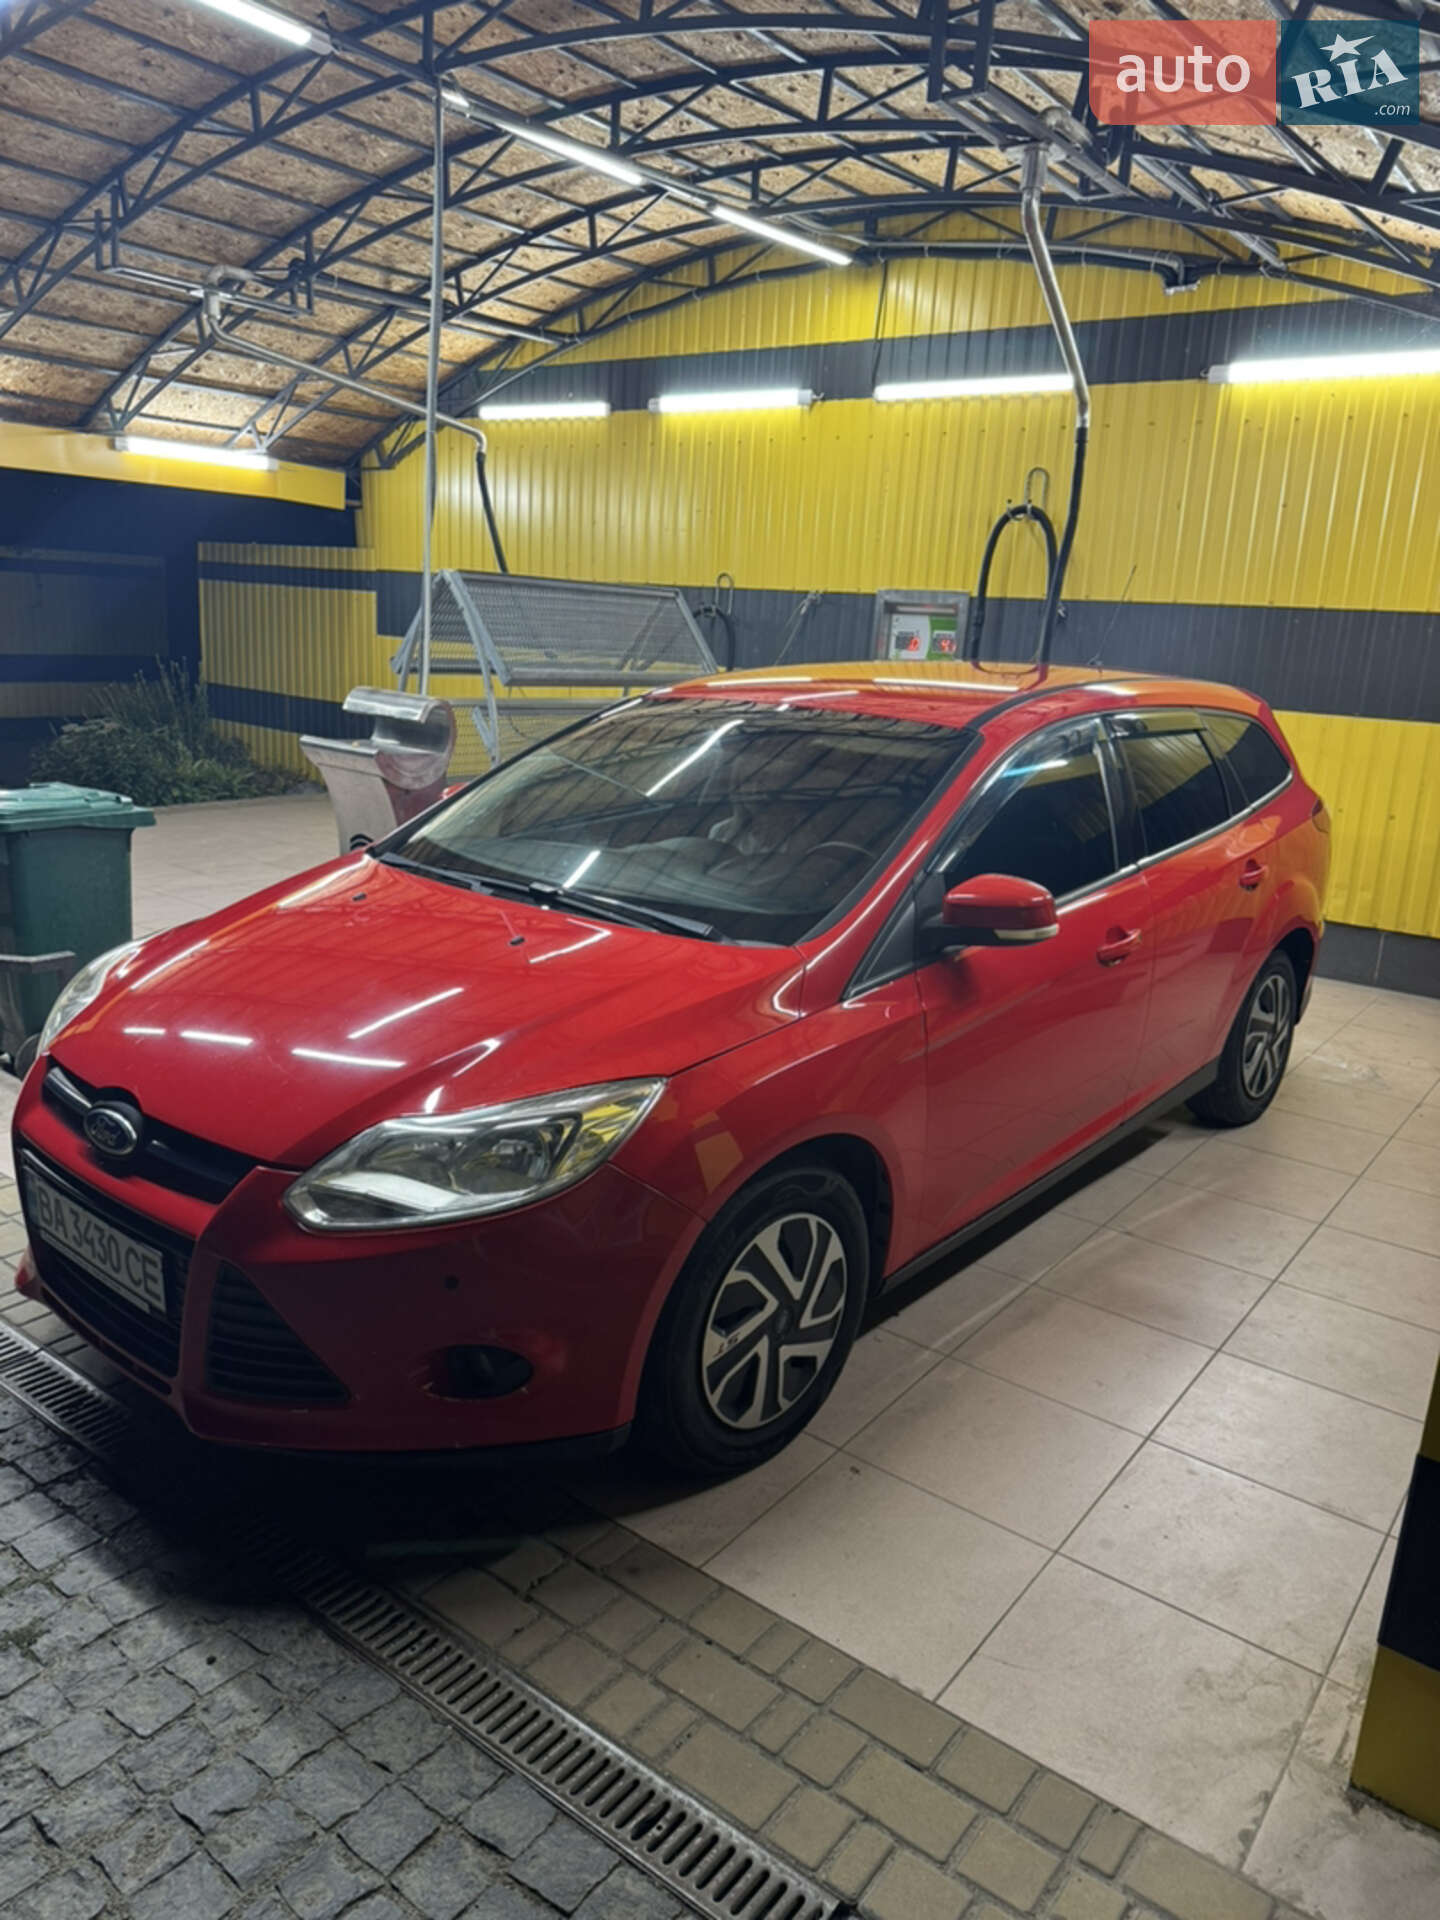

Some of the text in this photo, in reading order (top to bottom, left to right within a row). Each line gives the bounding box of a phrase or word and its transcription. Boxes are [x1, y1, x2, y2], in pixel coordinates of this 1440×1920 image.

[38, 1184, 161, 1302] BA 3430 CE
